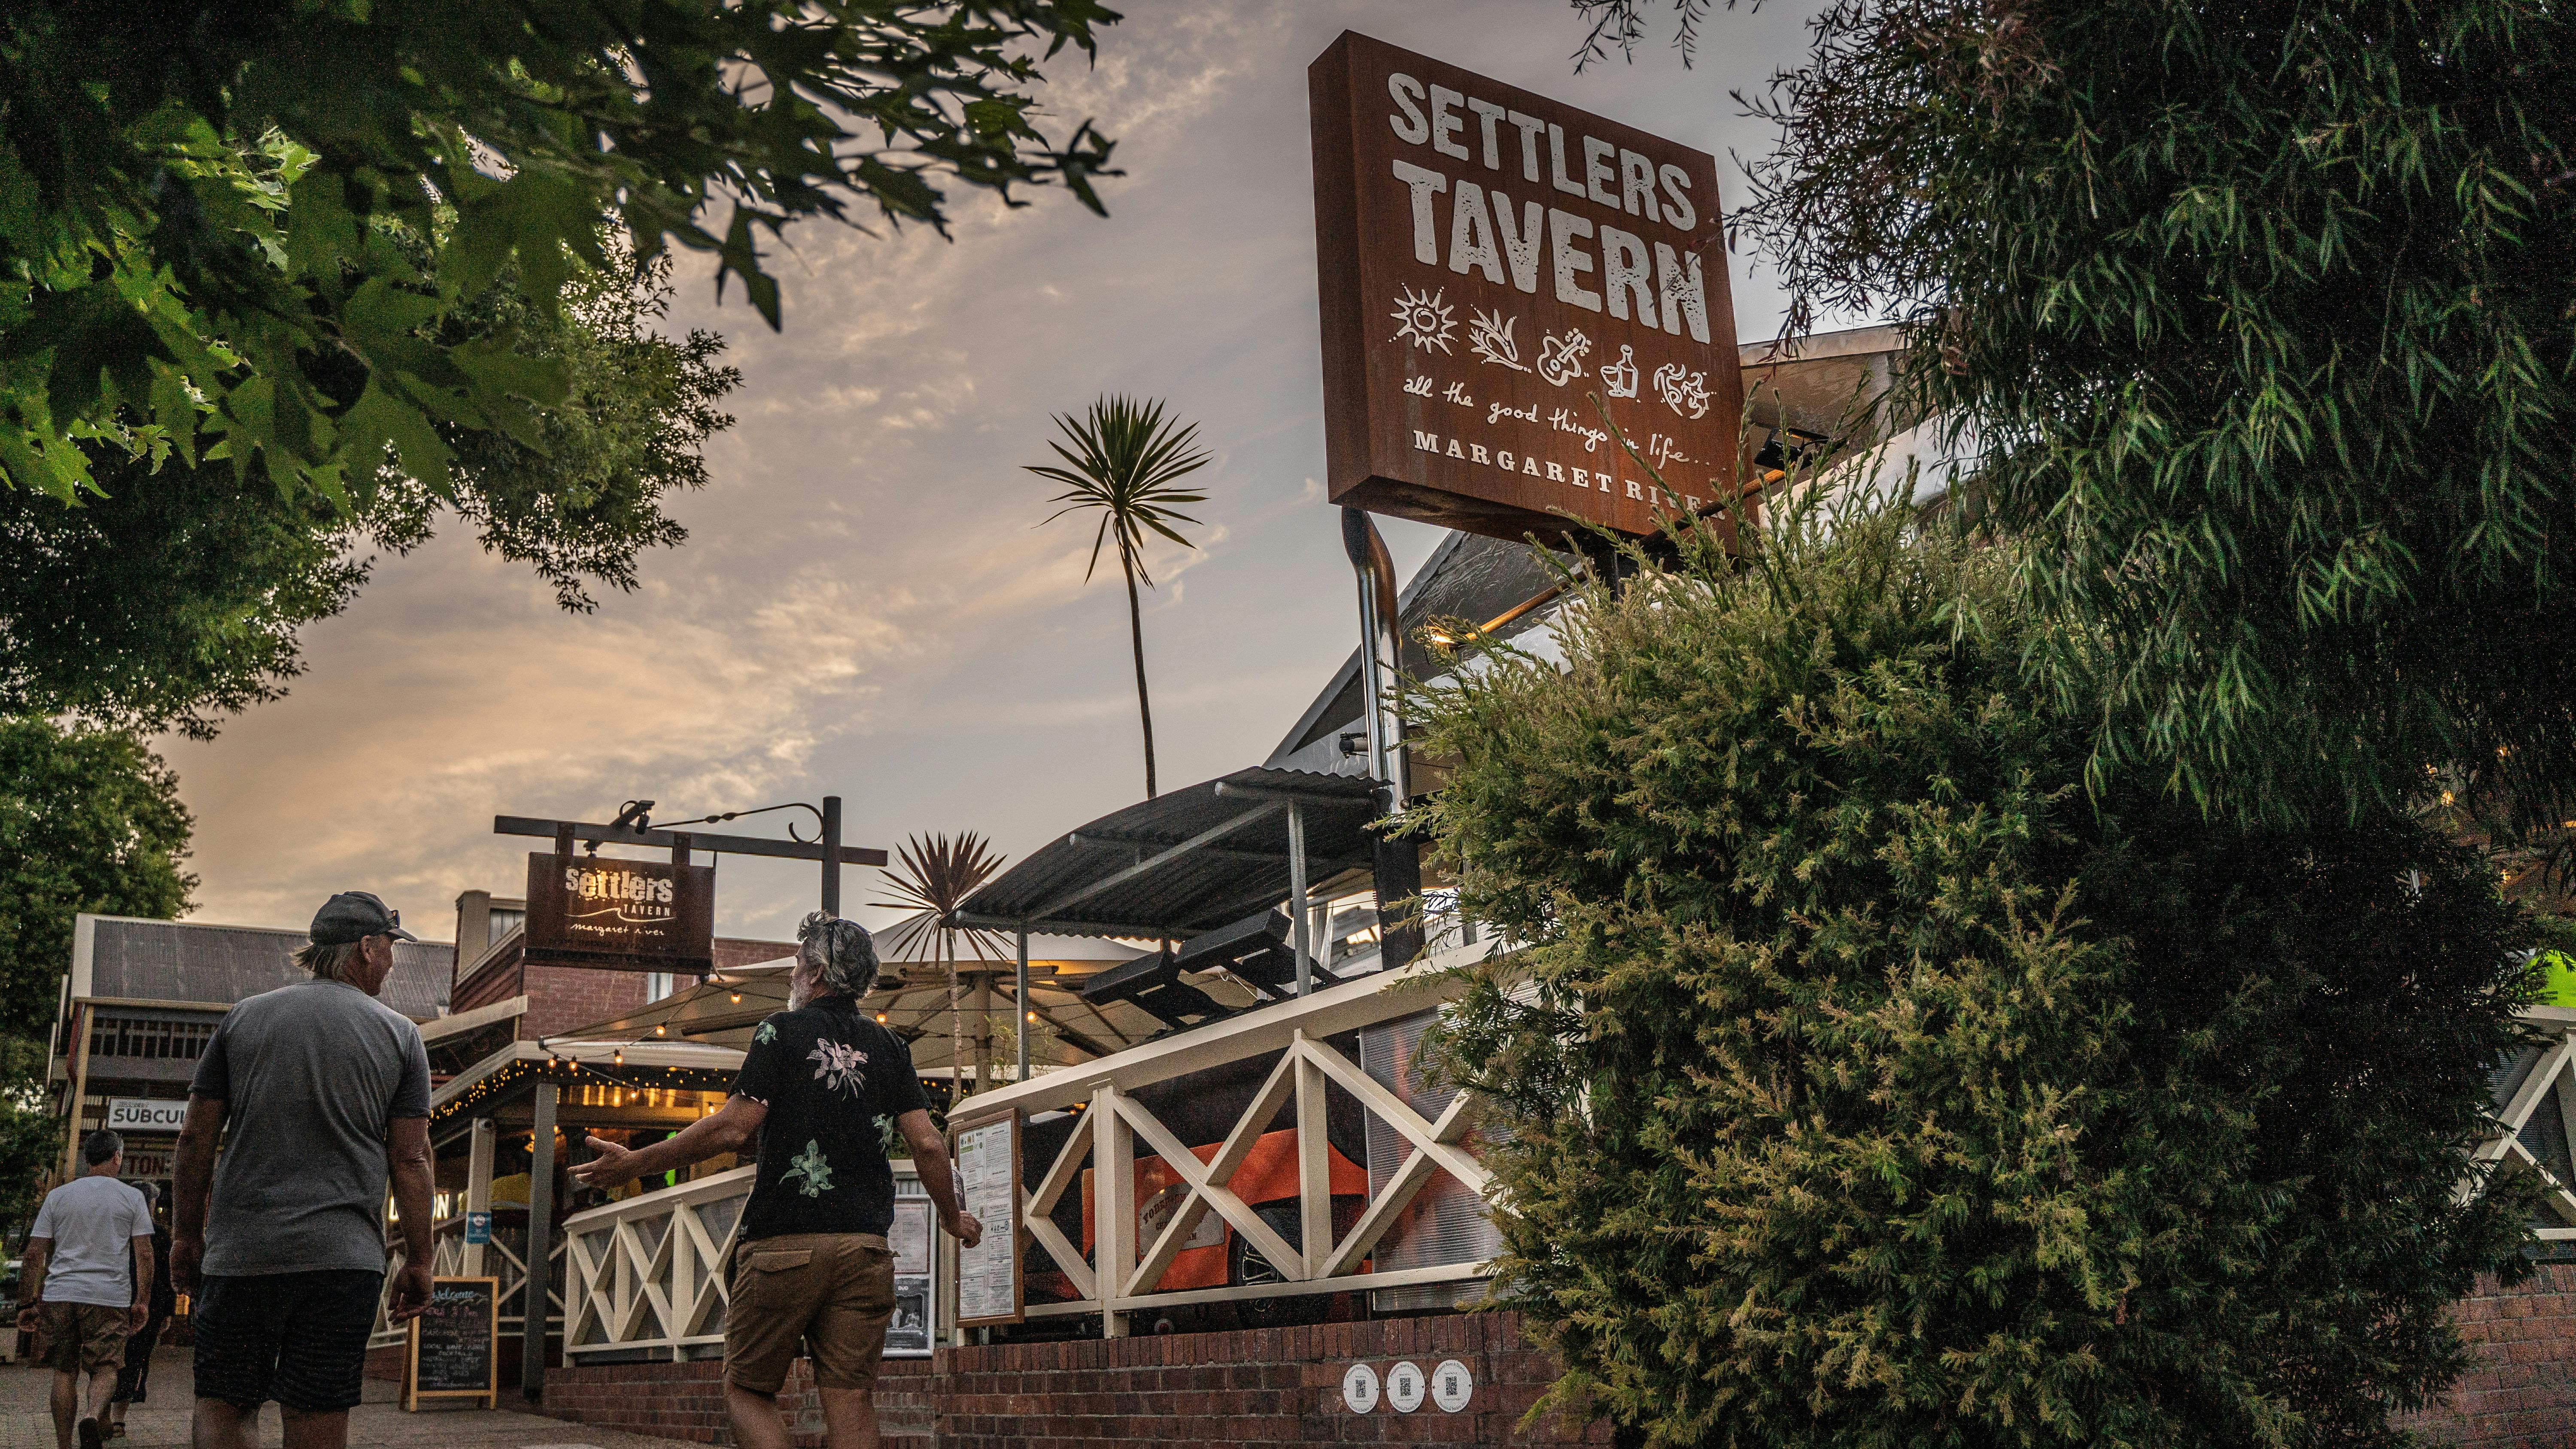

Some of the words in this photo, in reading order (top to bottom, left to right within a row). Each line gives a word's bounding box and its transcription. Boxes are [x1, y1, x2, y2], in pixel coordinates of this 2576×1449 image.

[1388, 73, 1696, 231] SETTLERS
[1392, 160, 1710, 344] TAVERN
[1403, 375, 1433, 397] all
[1442, 382, 1473, 407] the
[1487, 402, 1538, 424] good
[1547, 407, 1607, 452] things
[1413, 430, 1611, 493] MARGARET
[565, 867, 673, 903] settlers
[623, 903, 670, 916] TAVERN
[569, 923, 629, 937] margaret
